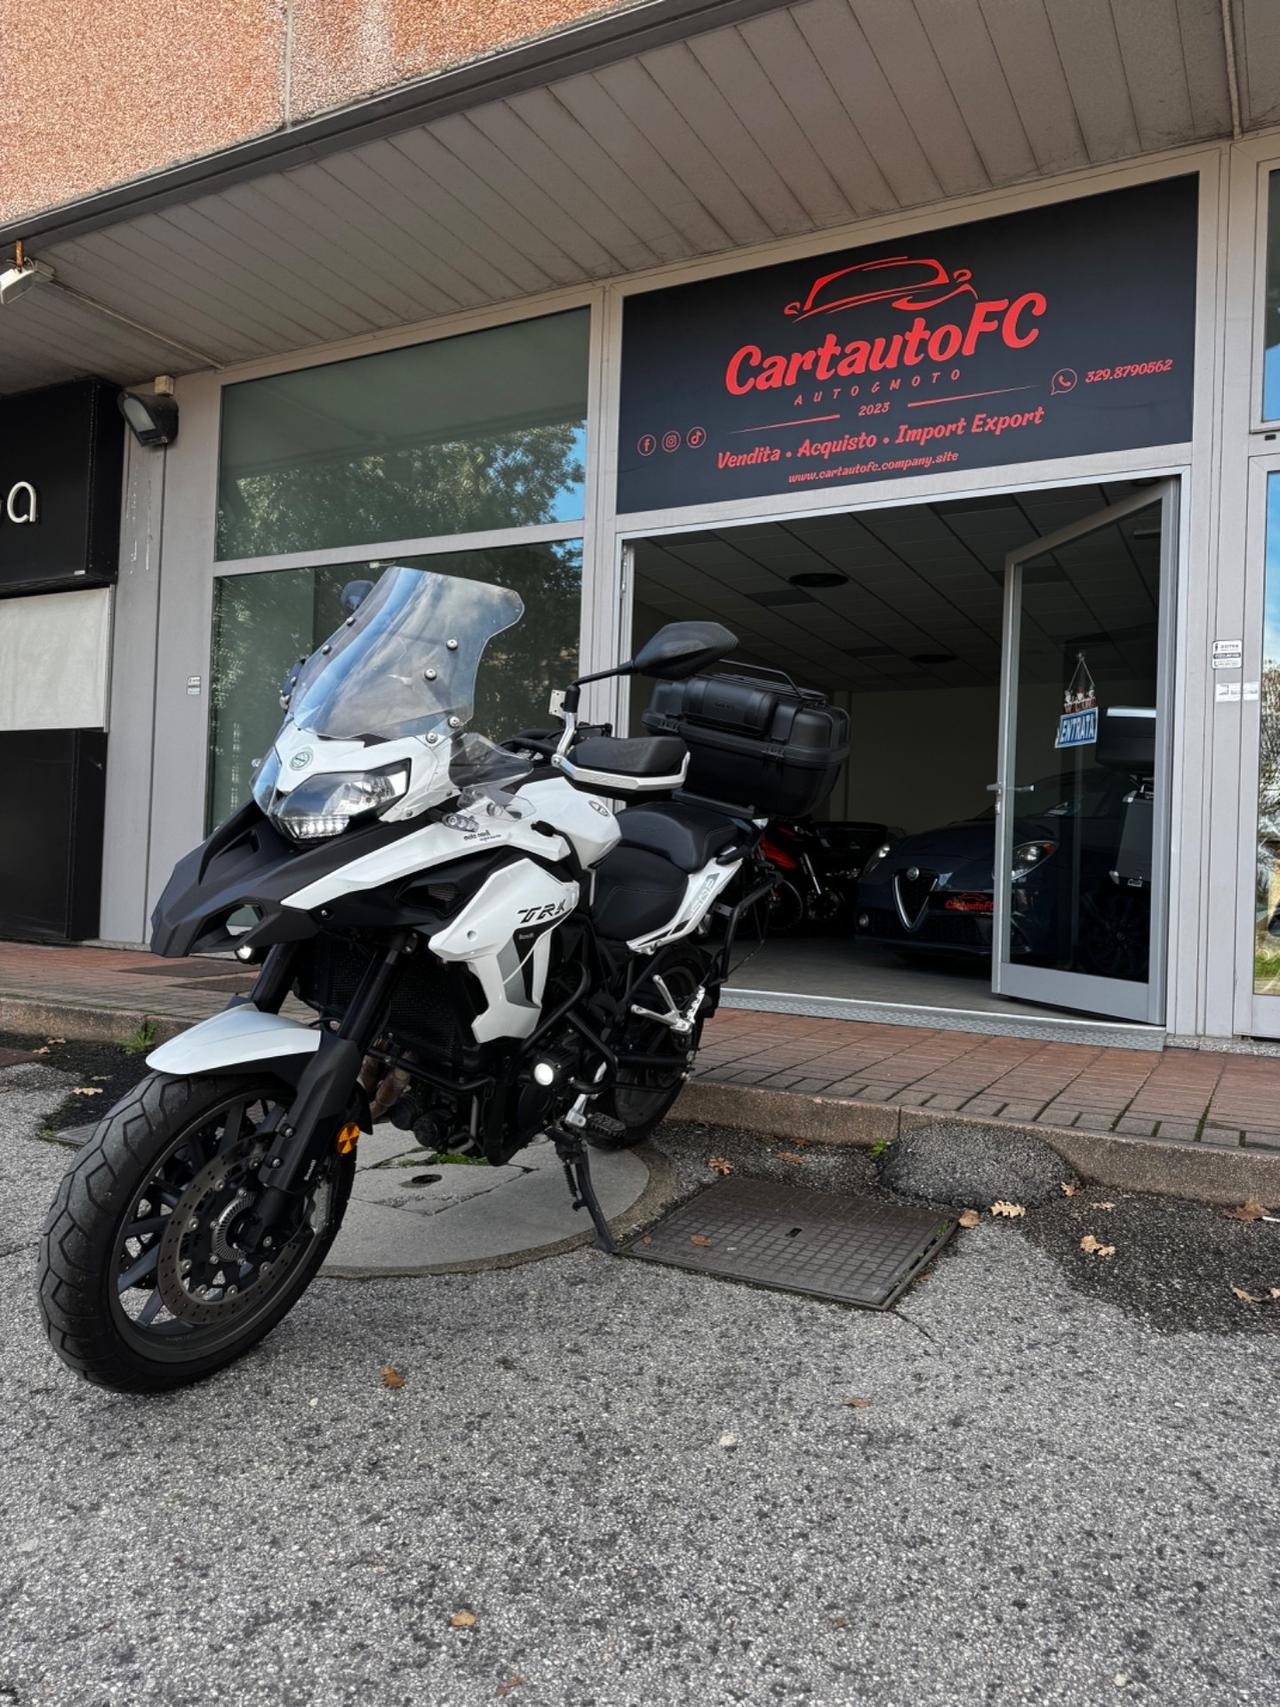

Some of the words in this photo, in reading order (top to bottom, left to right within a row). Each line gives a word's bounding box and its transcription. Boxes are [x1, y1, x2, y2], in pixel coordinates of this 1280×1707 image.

[724, 291, 1048, 397] CartautoFC
[1085, 359, 1174, 384] 329.8790562
[858, 401, 891, 417] 2023
[716, 446, 782, 470] Vendita
[797, 432, 878, 459] Acquisto
[895, 416, 967, 447] Import
[971, 406, 1045, 436] Export
[788, 450, 959, 483] www.cartautofc.company.site
[0, 481, 37, 523] a
[1060, 713, 1095, 743] ENTRATA
